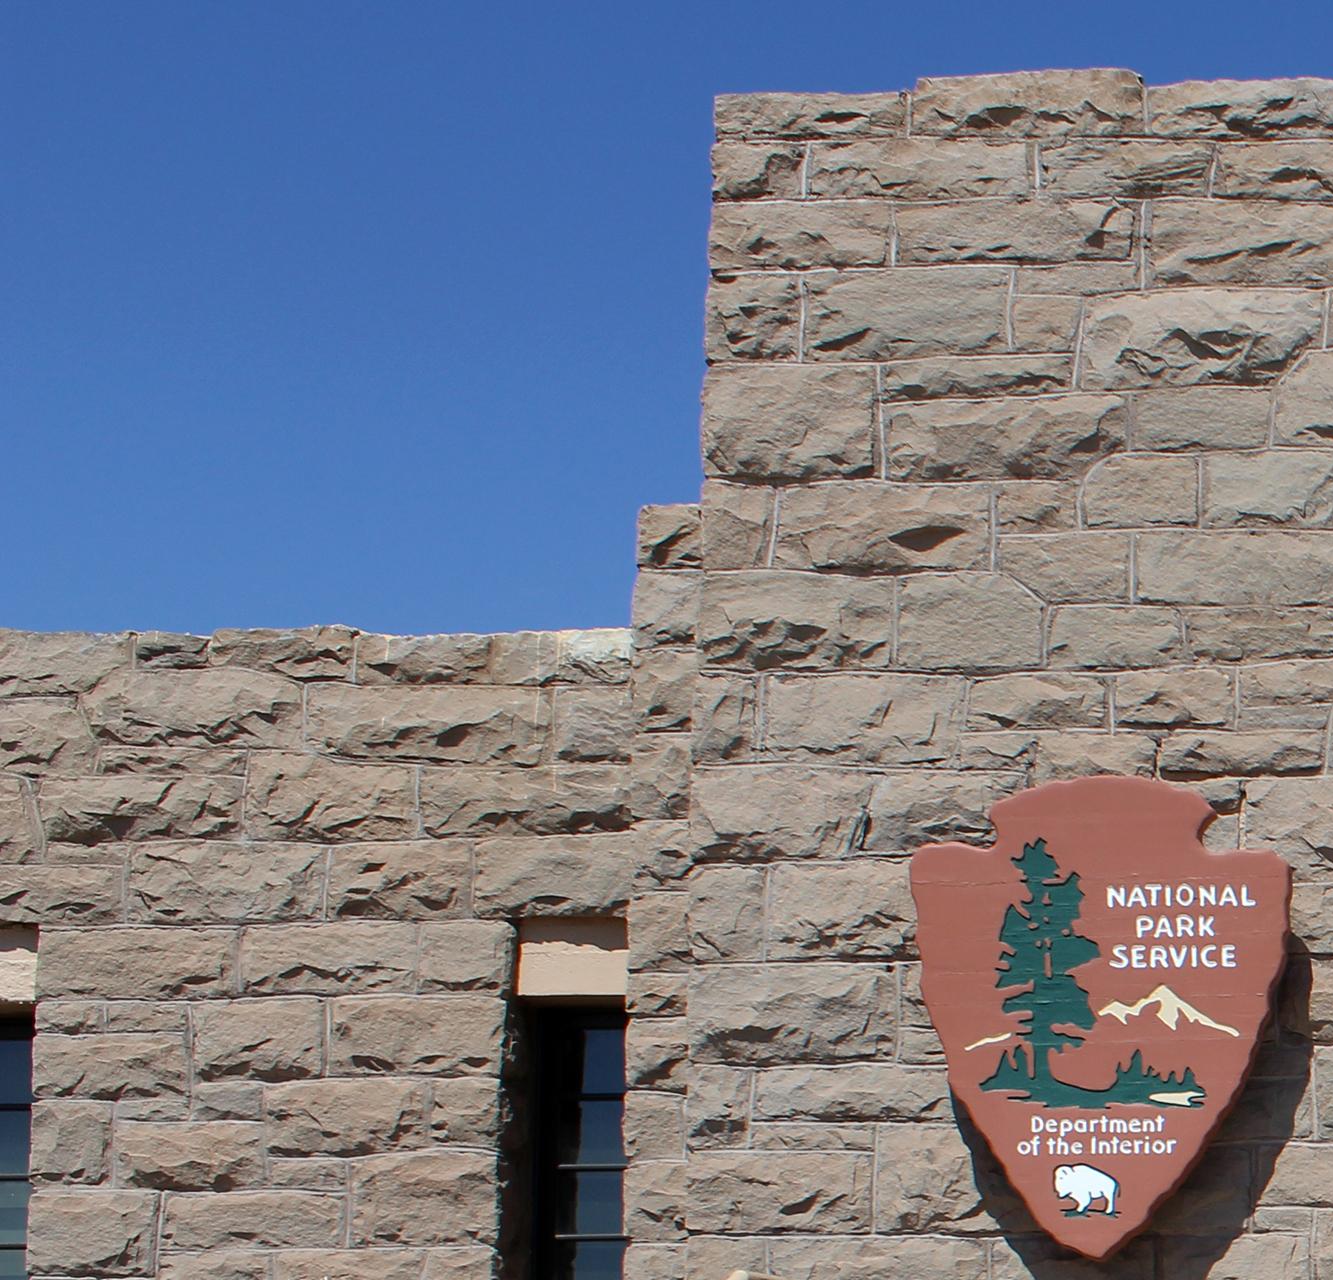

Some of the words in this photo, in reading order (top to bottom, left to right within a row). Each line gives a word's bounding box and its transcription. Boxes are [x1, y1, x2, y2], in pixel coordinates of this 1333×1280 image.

[1106, 883, 1258, 909] NATIONAL
[1136, 914, 1216, 939] PARK
[1109, 944, 1238, 969] SERVICE
[1030, 1115, 1166, 1137] Department
[1016, 1135, 1041, 1156] of
[1046, 1137, 1084, 1156] the
[1090, 1136, 1178, 1155] Interior
